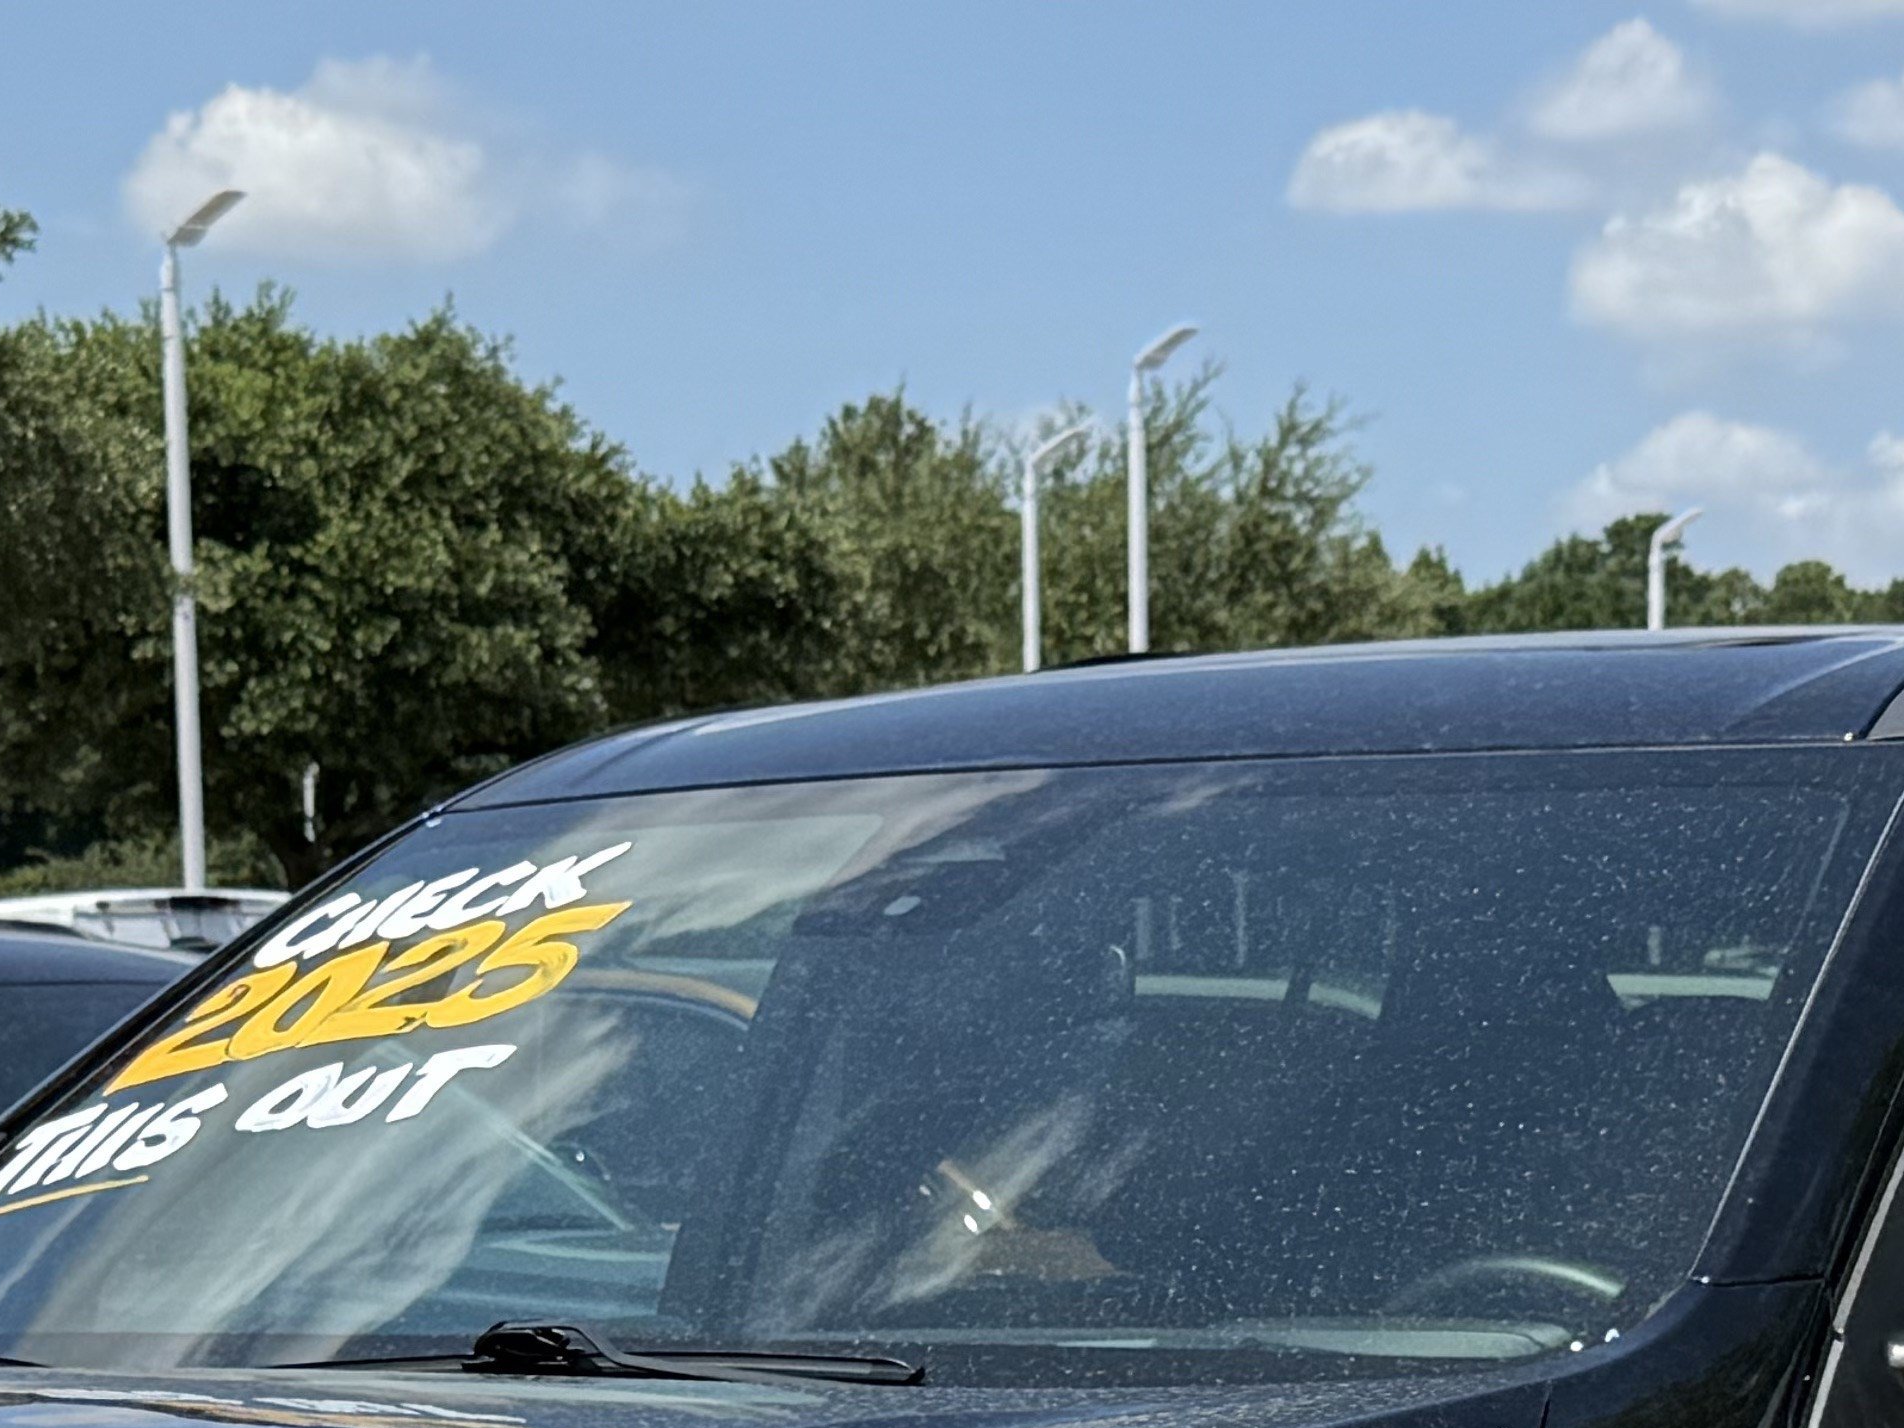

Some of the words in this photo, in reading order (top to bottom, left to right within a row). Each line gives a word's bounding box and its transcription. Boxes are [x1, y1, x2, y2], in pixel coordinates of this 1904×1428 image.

[255, 842, 633, 968] CHECK
[103, 901, 633, 1095] 2025
[235, 1044, 518, 1132] OUT
